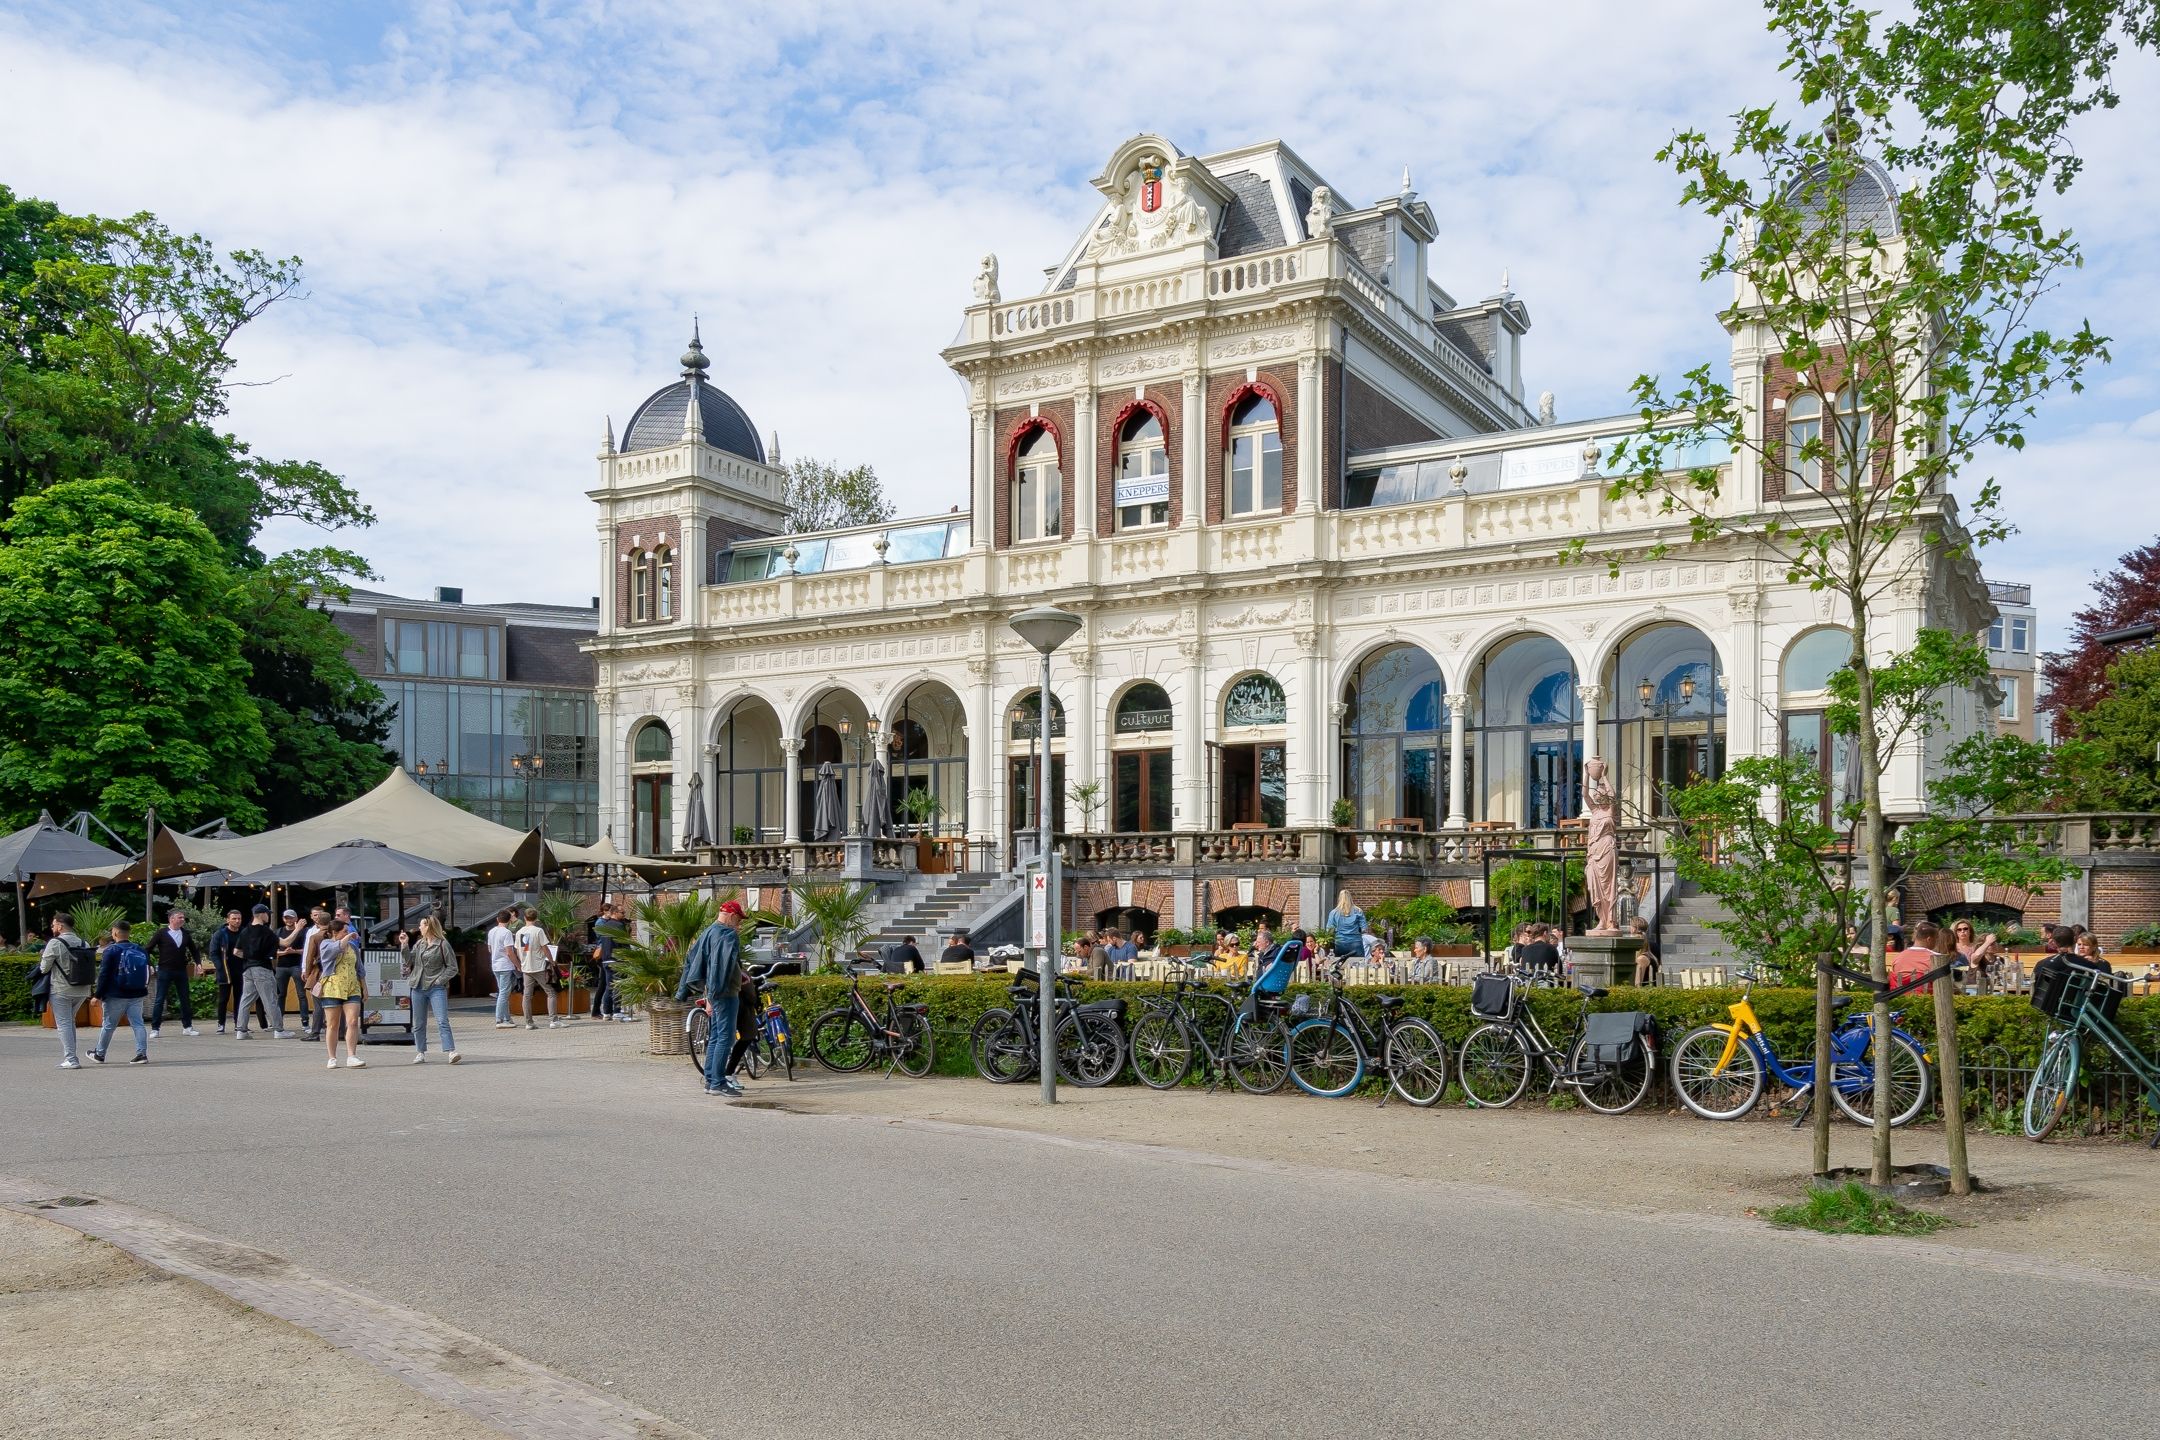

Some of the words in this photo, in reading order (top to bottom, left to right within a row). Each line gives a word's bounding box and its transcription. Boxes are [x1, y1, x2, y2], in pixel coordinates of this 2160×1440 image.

[1512, 458, 1576, 475] KNEPPERS
[1117, 483, 1169, 498] KNEPPERS
[1120, 712, 1170, 726] cultuur
